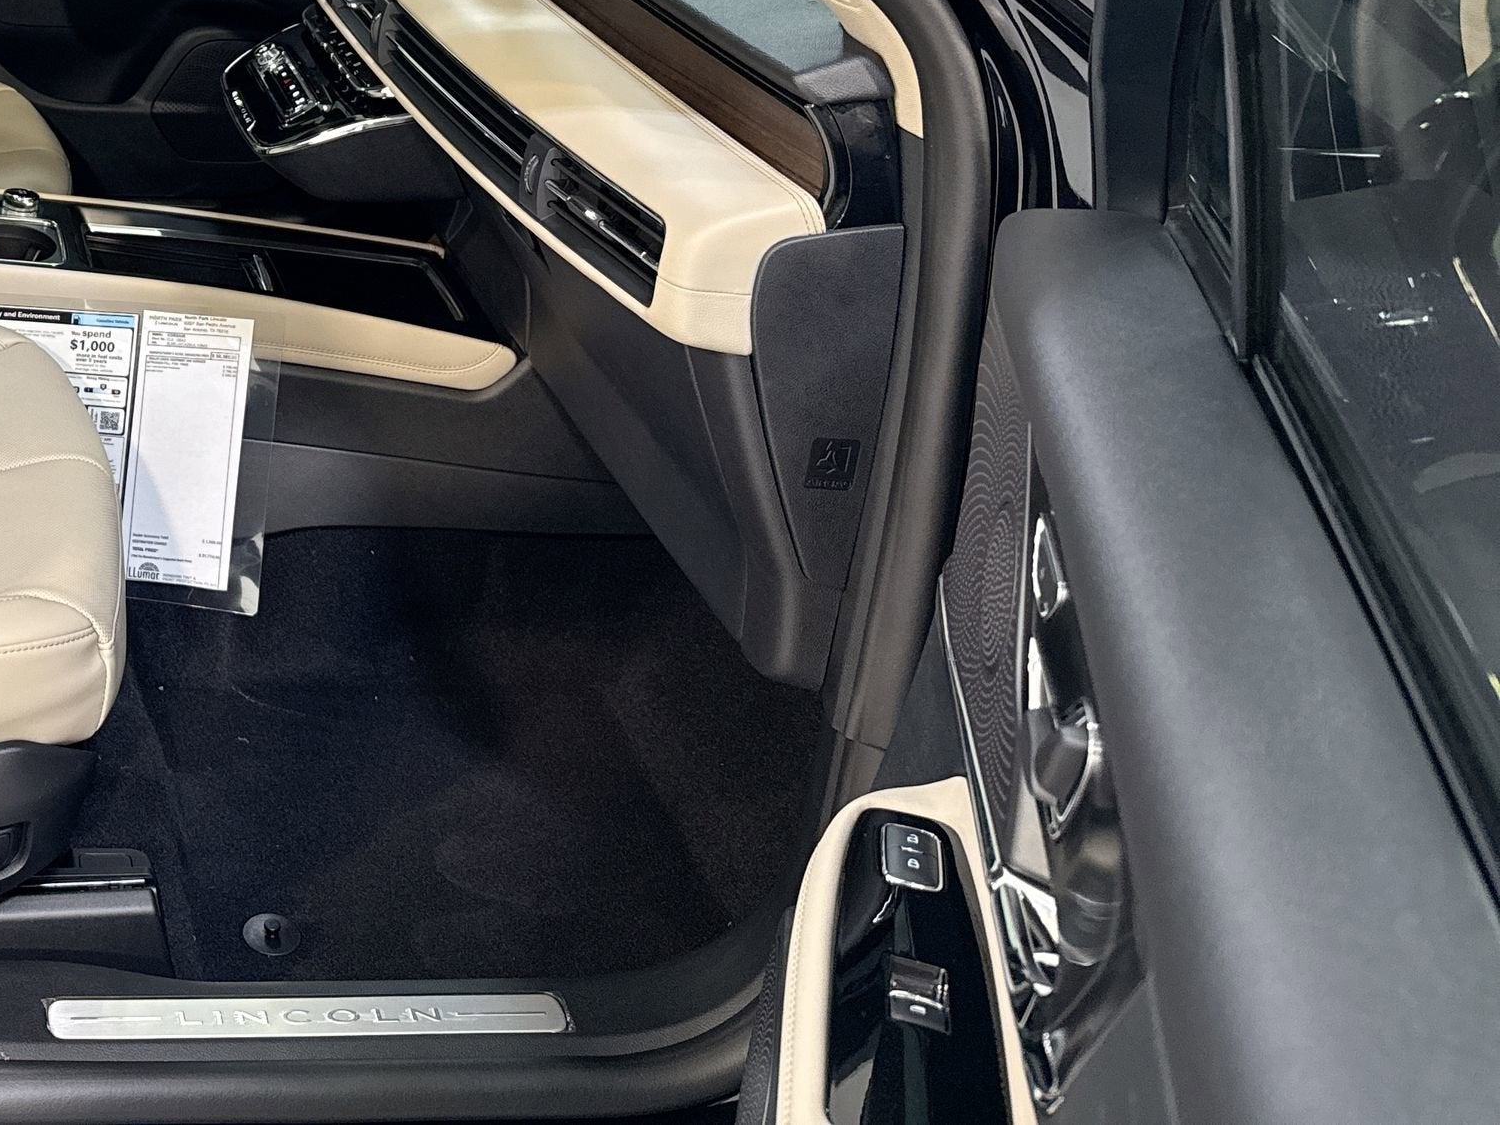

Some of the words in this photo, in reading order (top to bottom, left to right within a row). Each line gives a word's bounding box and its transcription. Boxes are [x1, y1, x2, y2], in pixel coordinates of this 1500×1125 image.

[3, 310, 16, 318] and
[17, 311, 61, 321] Environment
[82, 330, 112, 339] spend
[69, 338, 115, 353] $1,000
[128, 566, 160, 580] LLumar
[174, 1006, 445, 1026] LINCOLN
